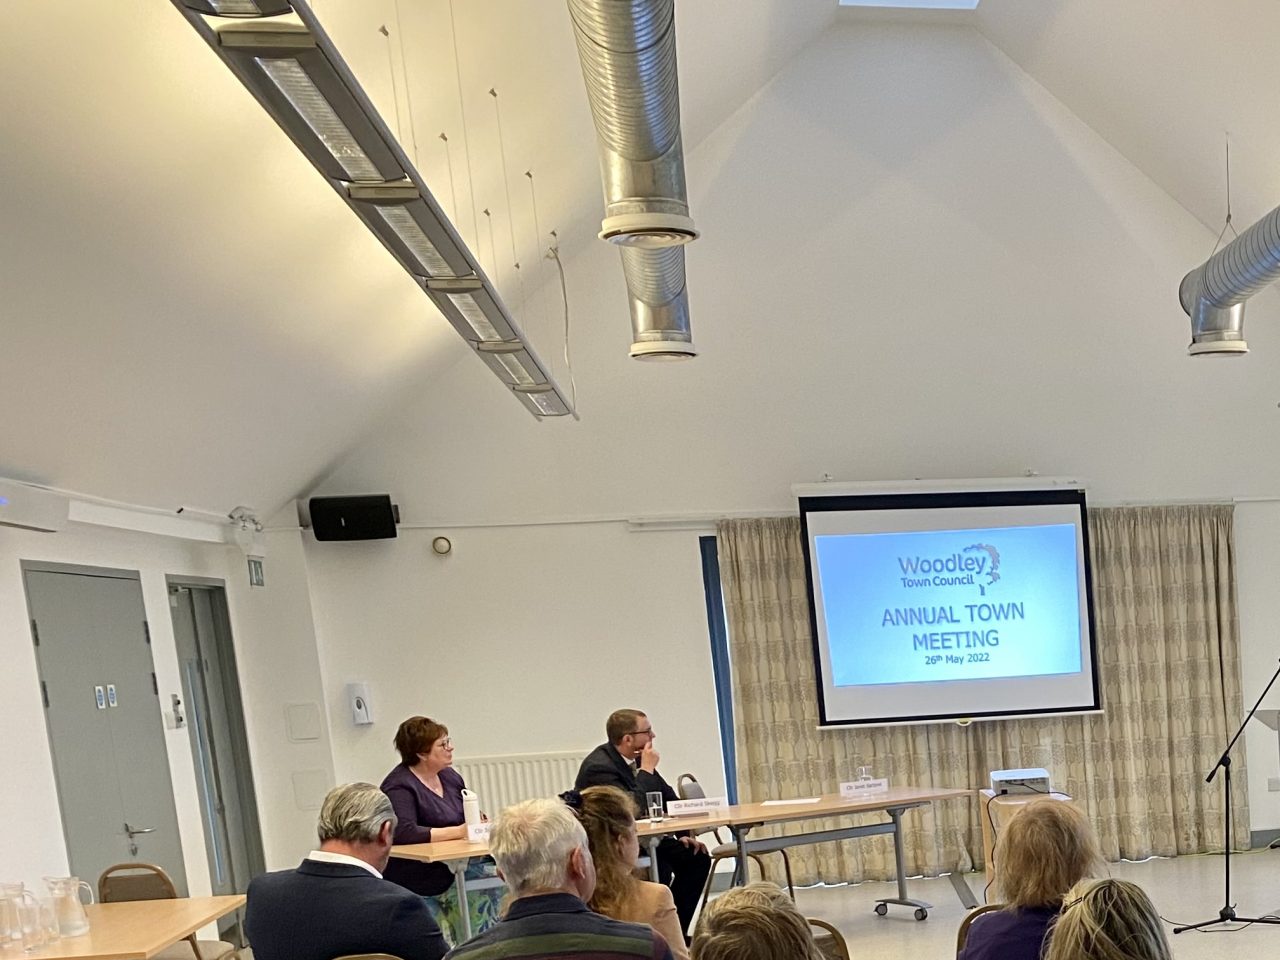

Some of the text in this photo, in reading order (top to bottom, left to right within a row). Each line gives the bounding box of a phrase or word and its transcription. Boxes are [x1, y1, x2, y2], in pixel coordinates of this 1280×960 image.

[897, 553, 986, 575] Woodley
[900, 574, 975, 588] Town Council
[881, 601, 1025, 628] ANNUAL TOWN
[912, 629, 1000, 651] MEETING
[925, 652, 990, 665] 26th May 2022
